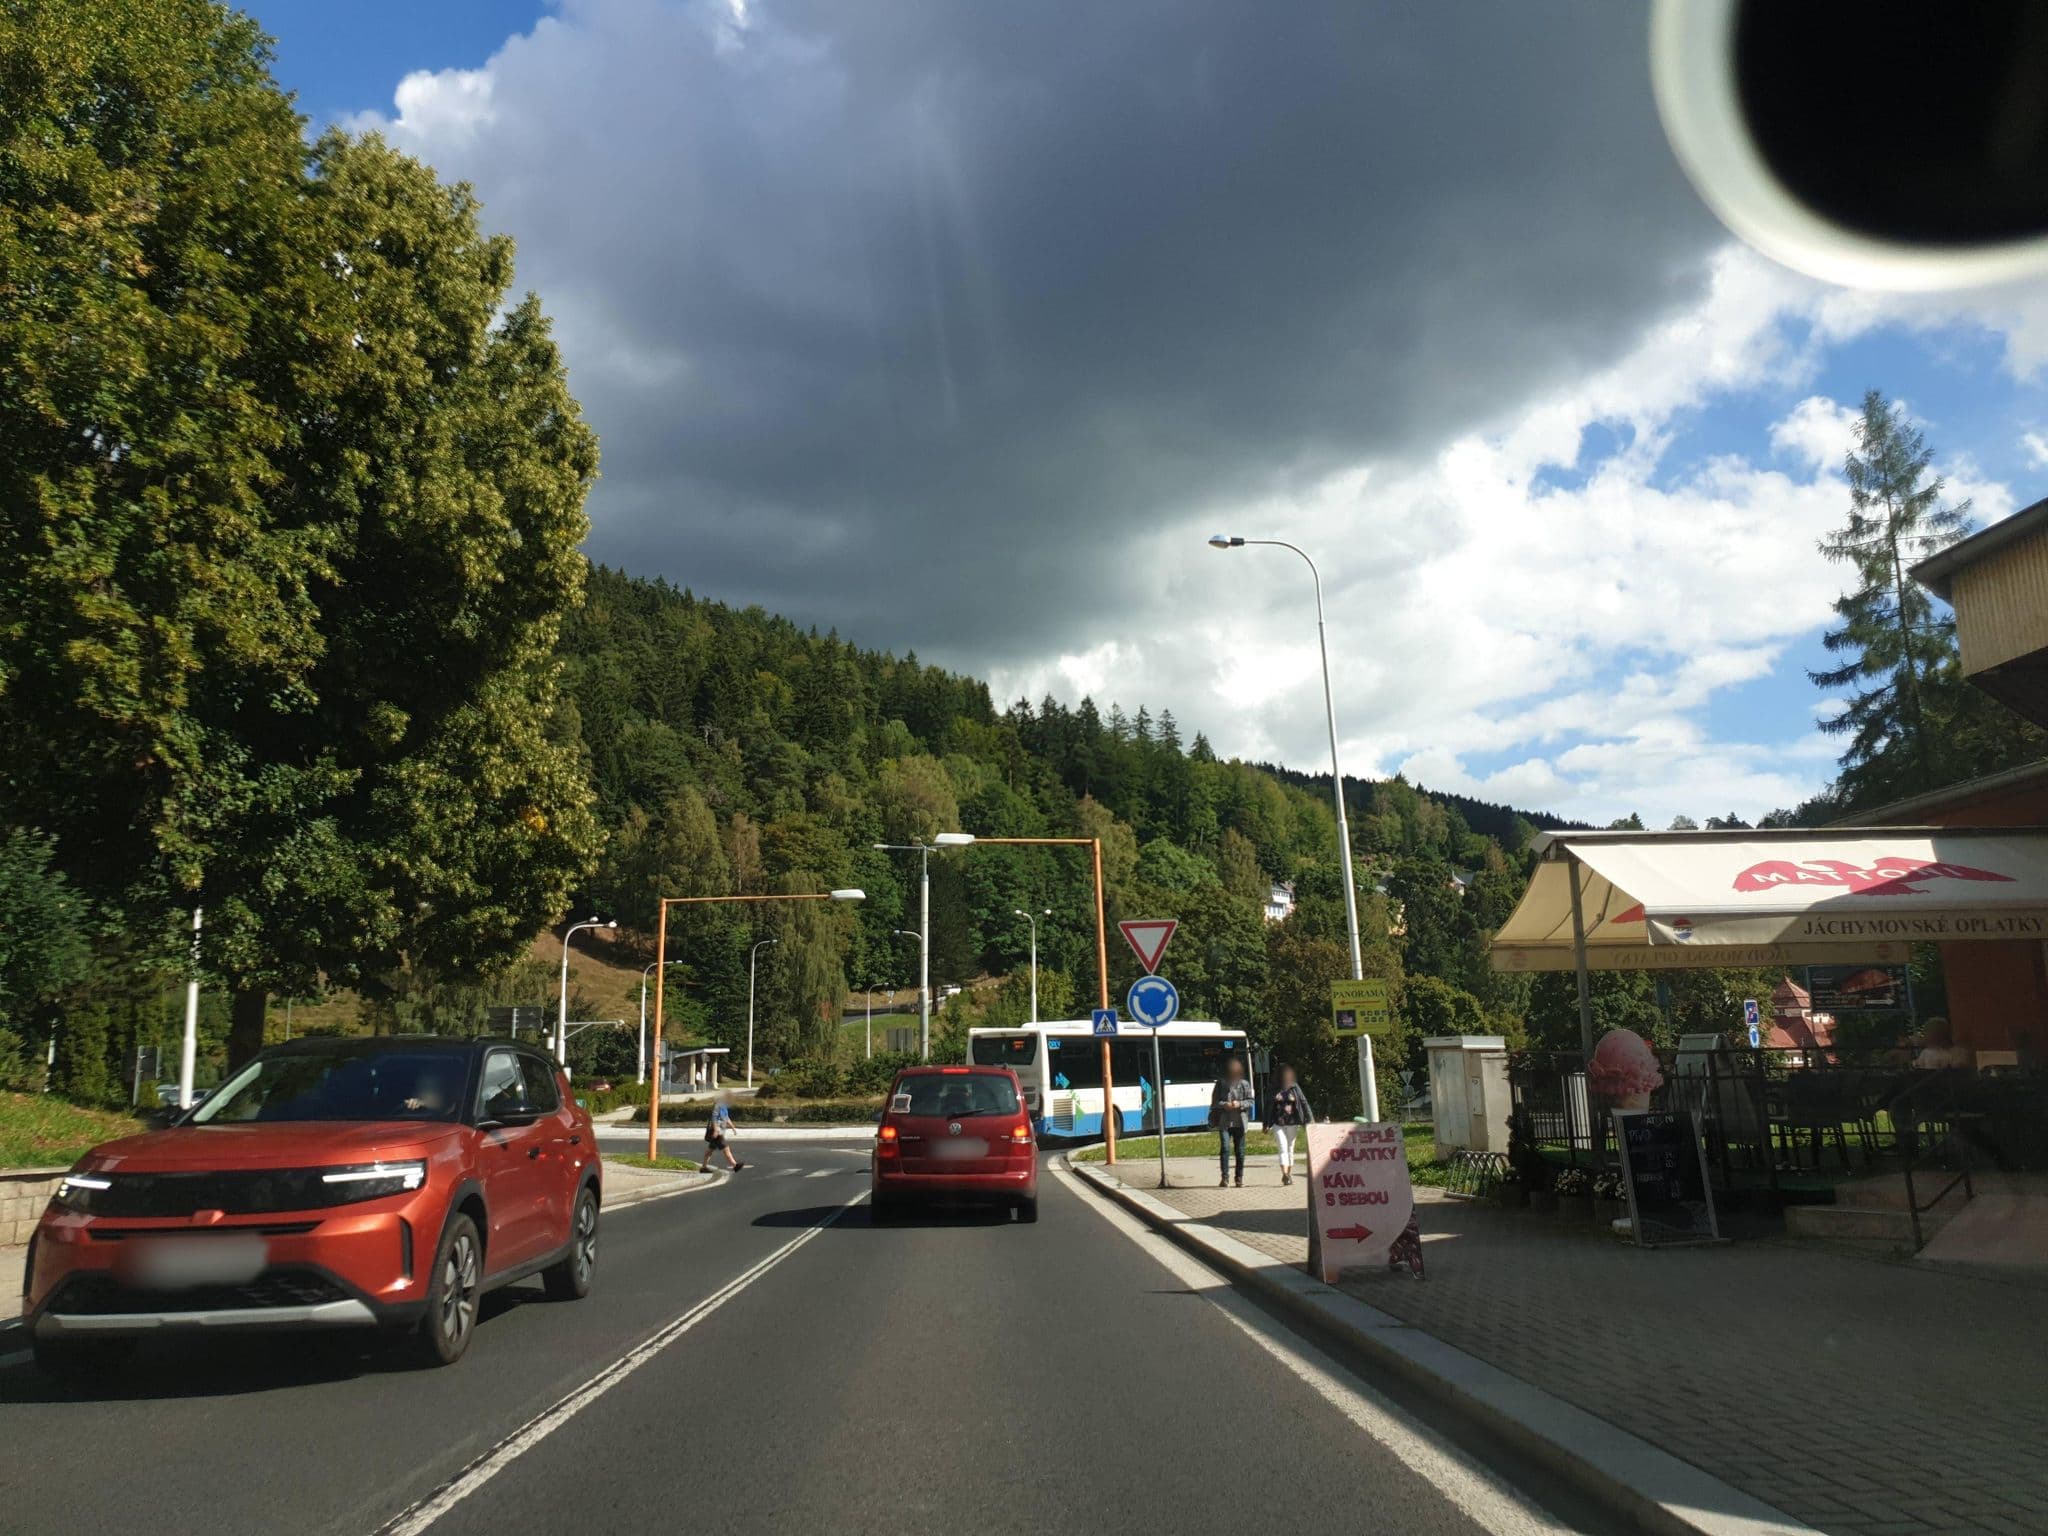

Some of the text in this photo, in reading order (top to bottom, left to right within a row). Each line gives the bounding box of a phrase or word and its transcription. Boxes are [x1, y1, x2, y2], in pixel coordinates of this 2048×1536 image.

[1751, 866, 1964, 883] MATTONI
[1804, 915, 2044, 935] JÁCHYMOVSKÉ OPLATKY
[1333, 988, 1385, 999] PANORAMA
[1348, 1126, 1397, 1144] TEPLÉ
[1330, 1147, 1398, 1162] OPLATKY
[1322, 1172, 1366, 1189] KÁVA
[1325, 1190, 1389, 1207] S SEBOU
